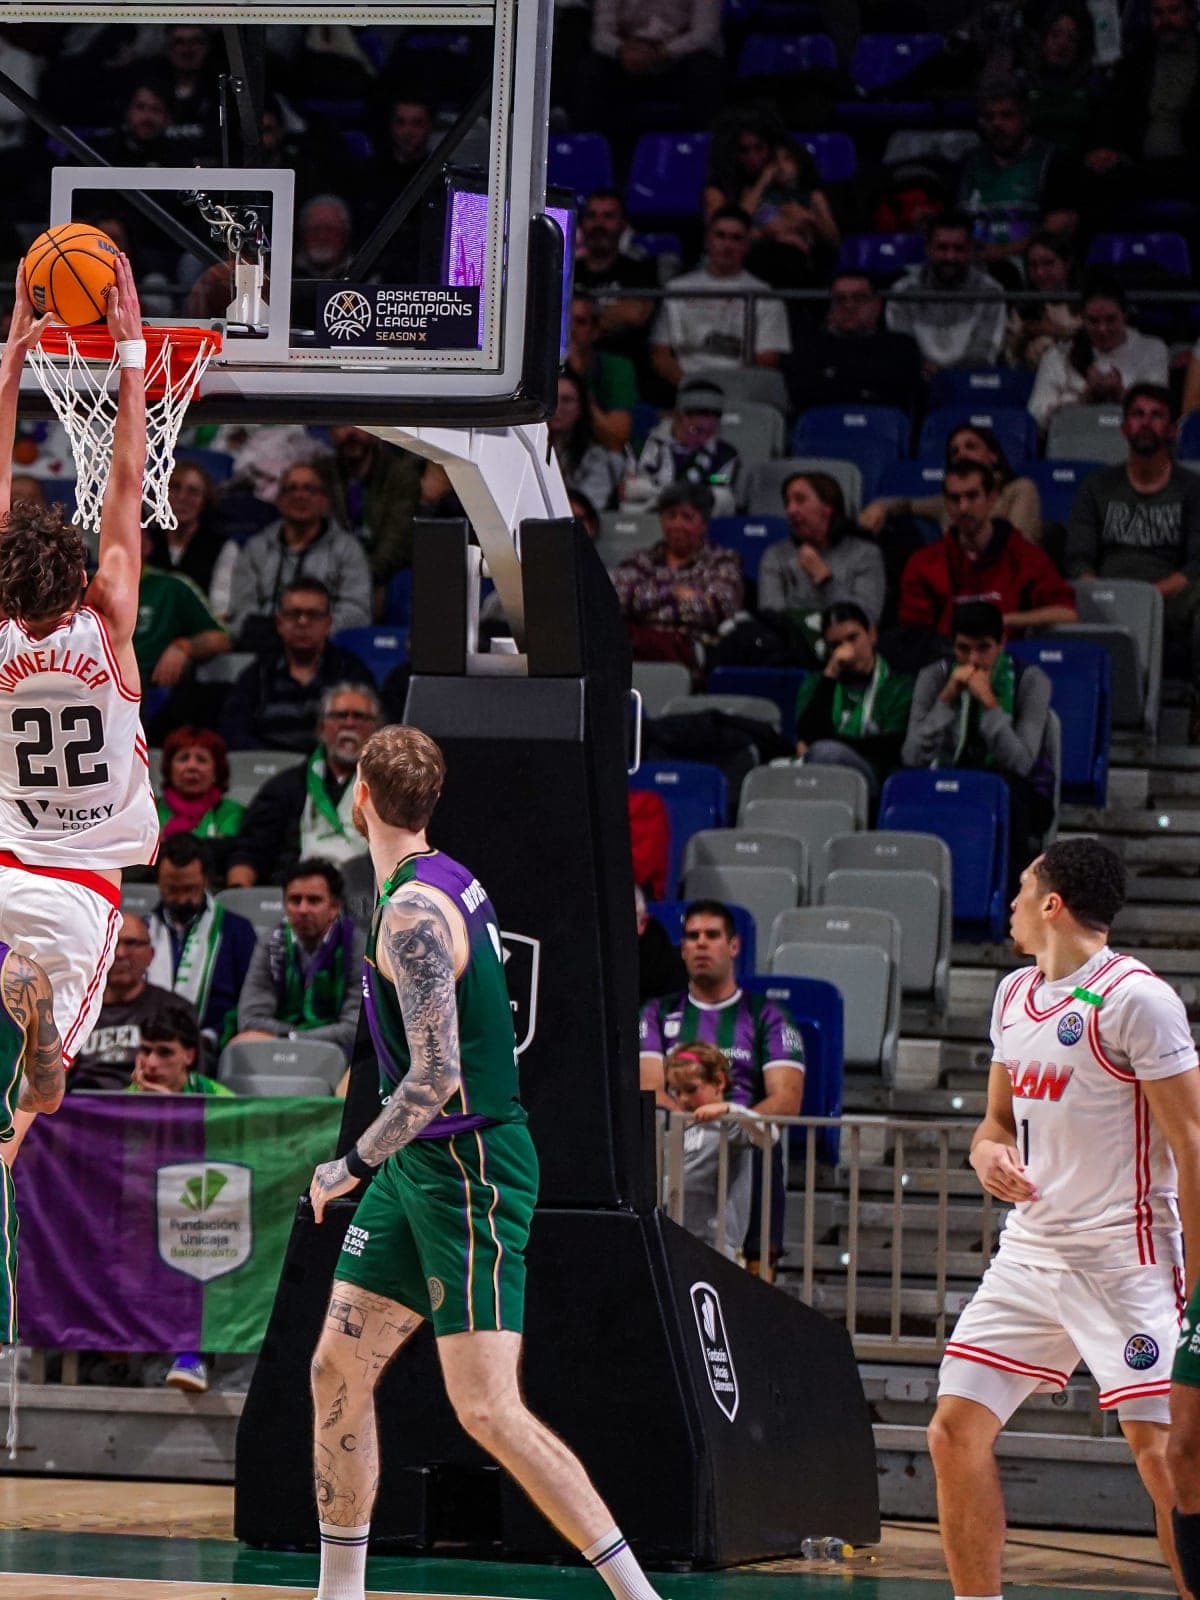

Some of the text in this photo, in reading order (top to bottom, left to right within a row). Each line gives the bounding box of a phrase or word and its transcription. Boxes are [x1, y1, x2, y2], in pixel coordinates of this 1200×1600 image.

[376, 290, 462, 302] BASKETBALL
[375, 303, 473, 316] CHAMPIONS
[375, 317, 428, 328] LEAGUE
[375, 331, 417, 341] SEASON
[11, 705, 110, 787] 22
[55, 803, 114, 822] VICKY
[80, 1024, 142, 1055] UEEN
[180, 1233, 228, 1247] Unicaja
